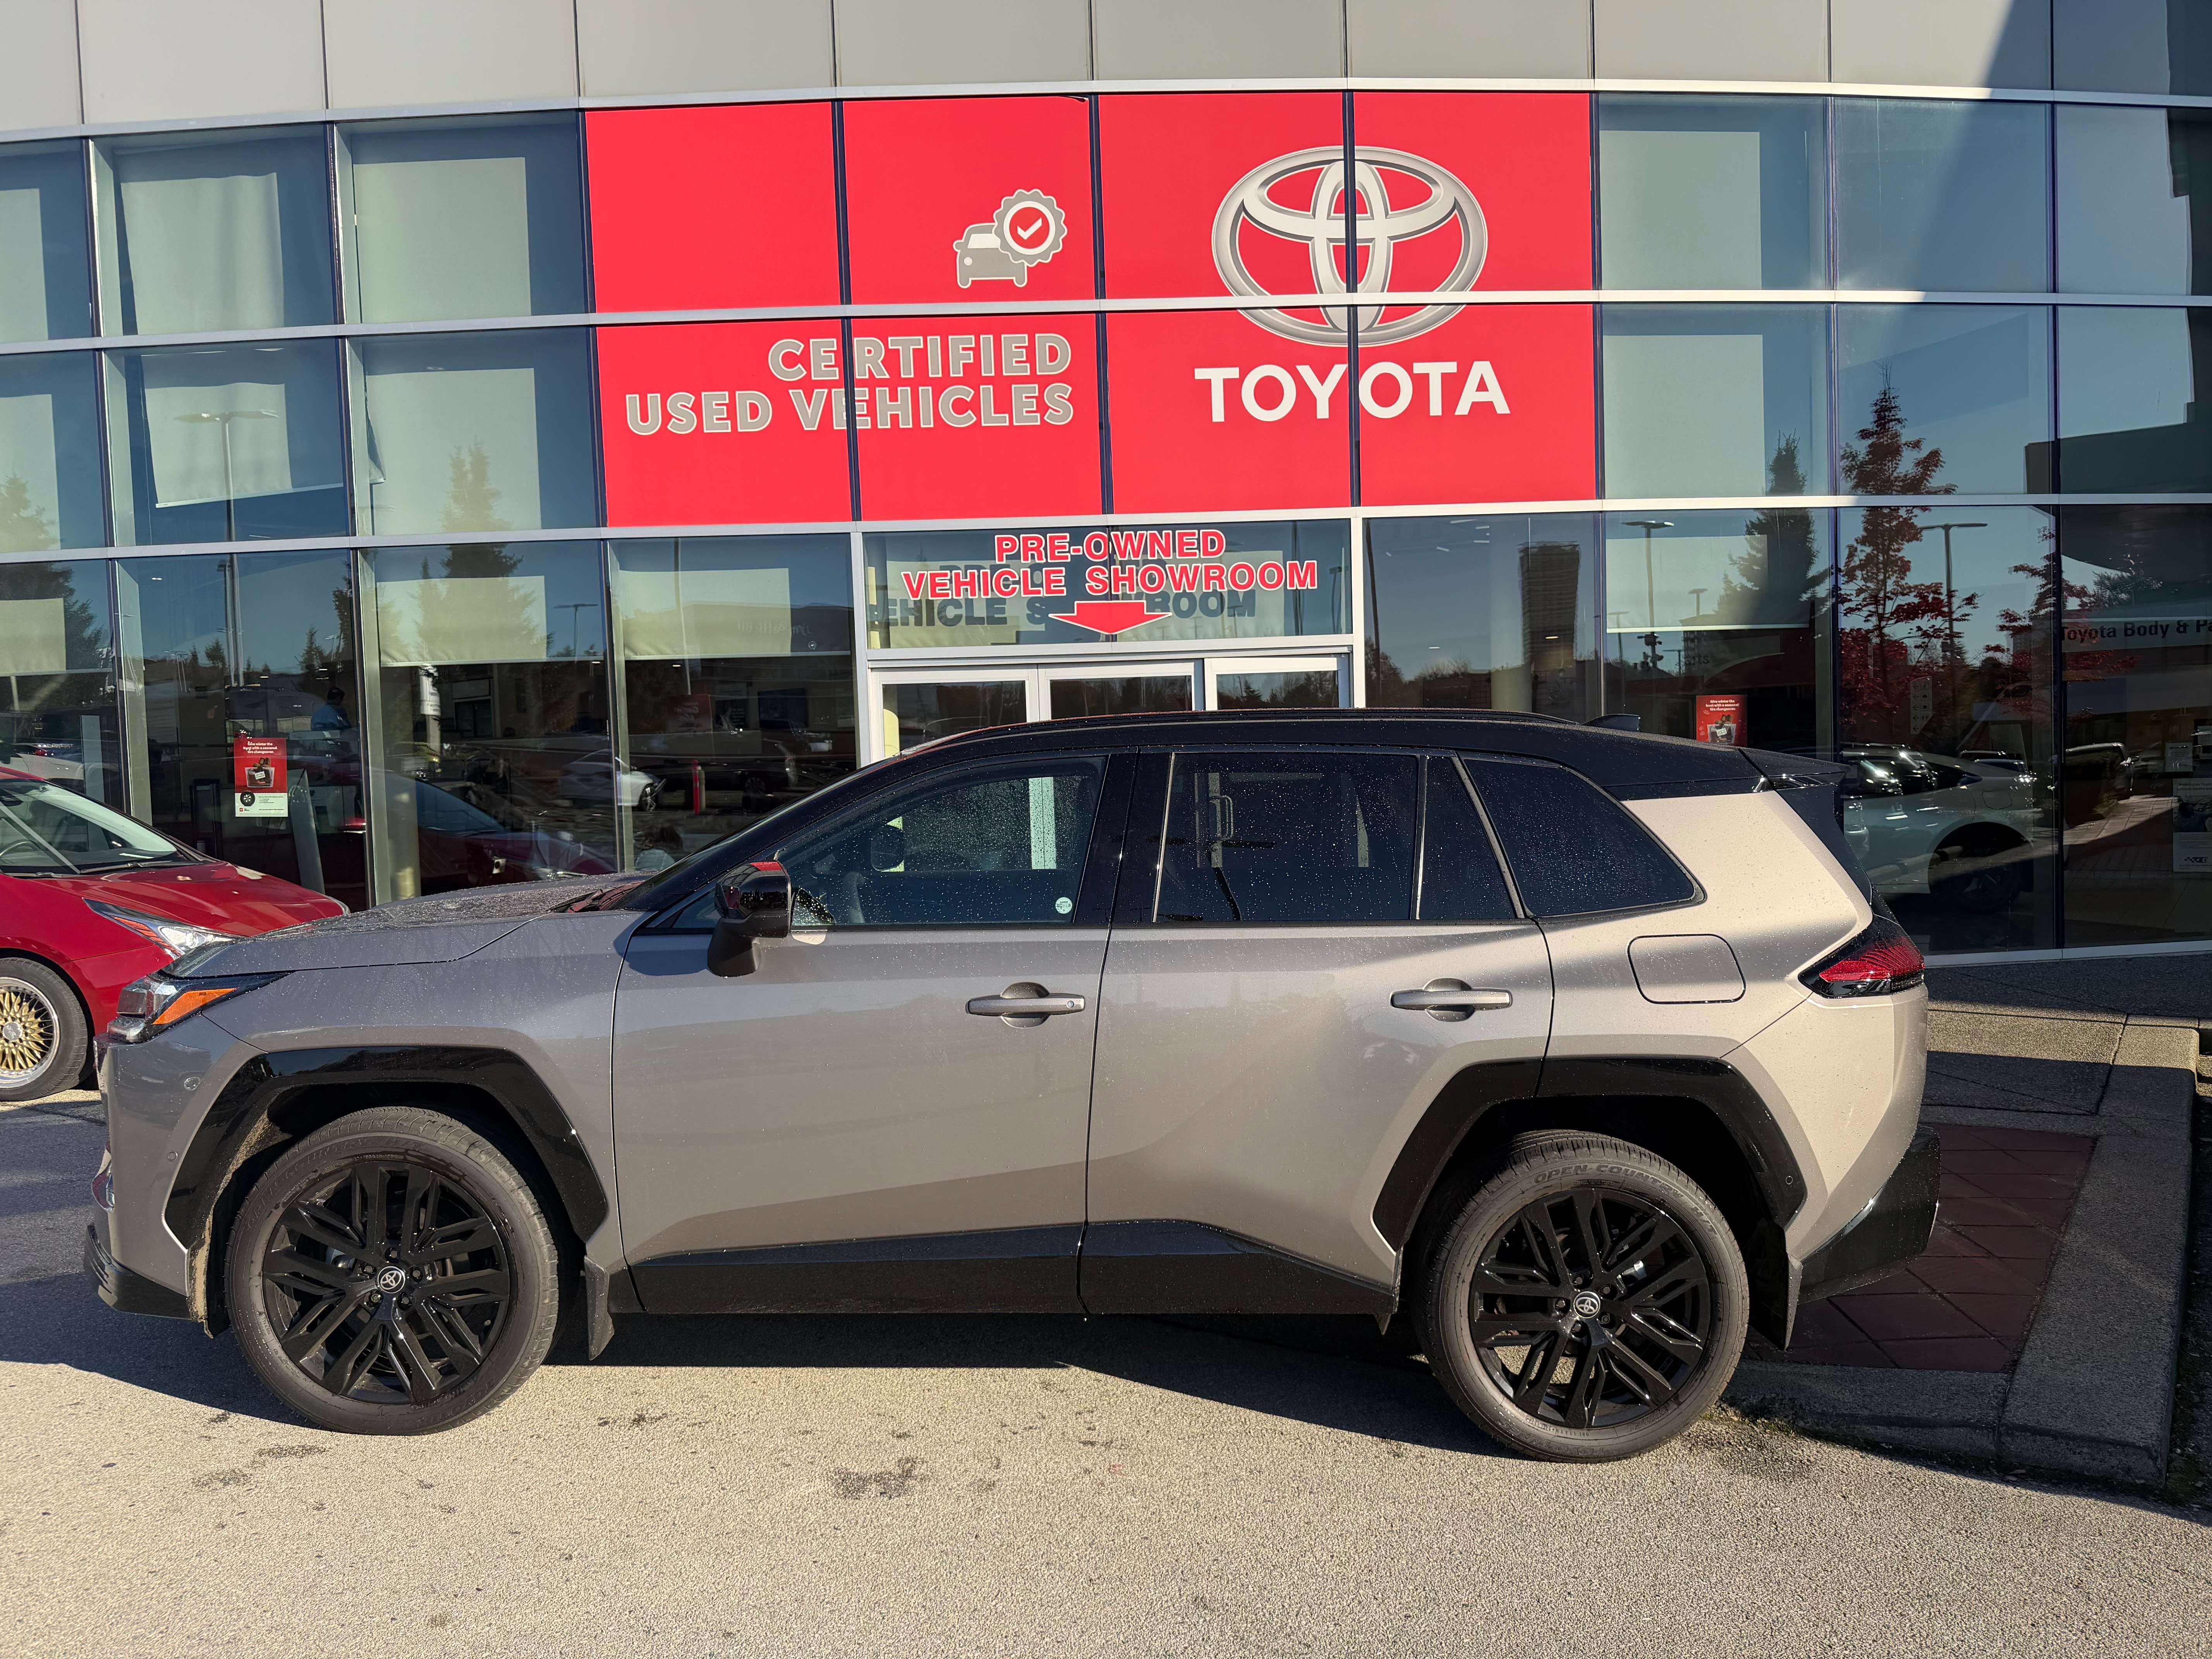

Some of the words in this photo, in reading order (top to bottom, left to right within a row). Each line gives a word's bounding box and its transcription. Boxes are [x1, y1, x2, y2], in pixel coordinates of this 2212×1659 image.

[768, 333, 1072, 381] CERTIFIED
[625, 390, 773, 436] USED
[788, 383, 1074, 431] VEHICLES
[1194, 361, 1511, 422] TOYOTA
[994, 529, 1226, 563] PRE-OWNED
[902, 565, 1067, 600] VEHICLE
[1085, 560, 1318, 595] SHOWROOM
[2124, 621, 2169, 638] Body
[2176, 620, 2189, 634] &
[1533, 1164, 1588, 1184] OPEN
[1595, 1164, 1684, 1198] COUNTRY
